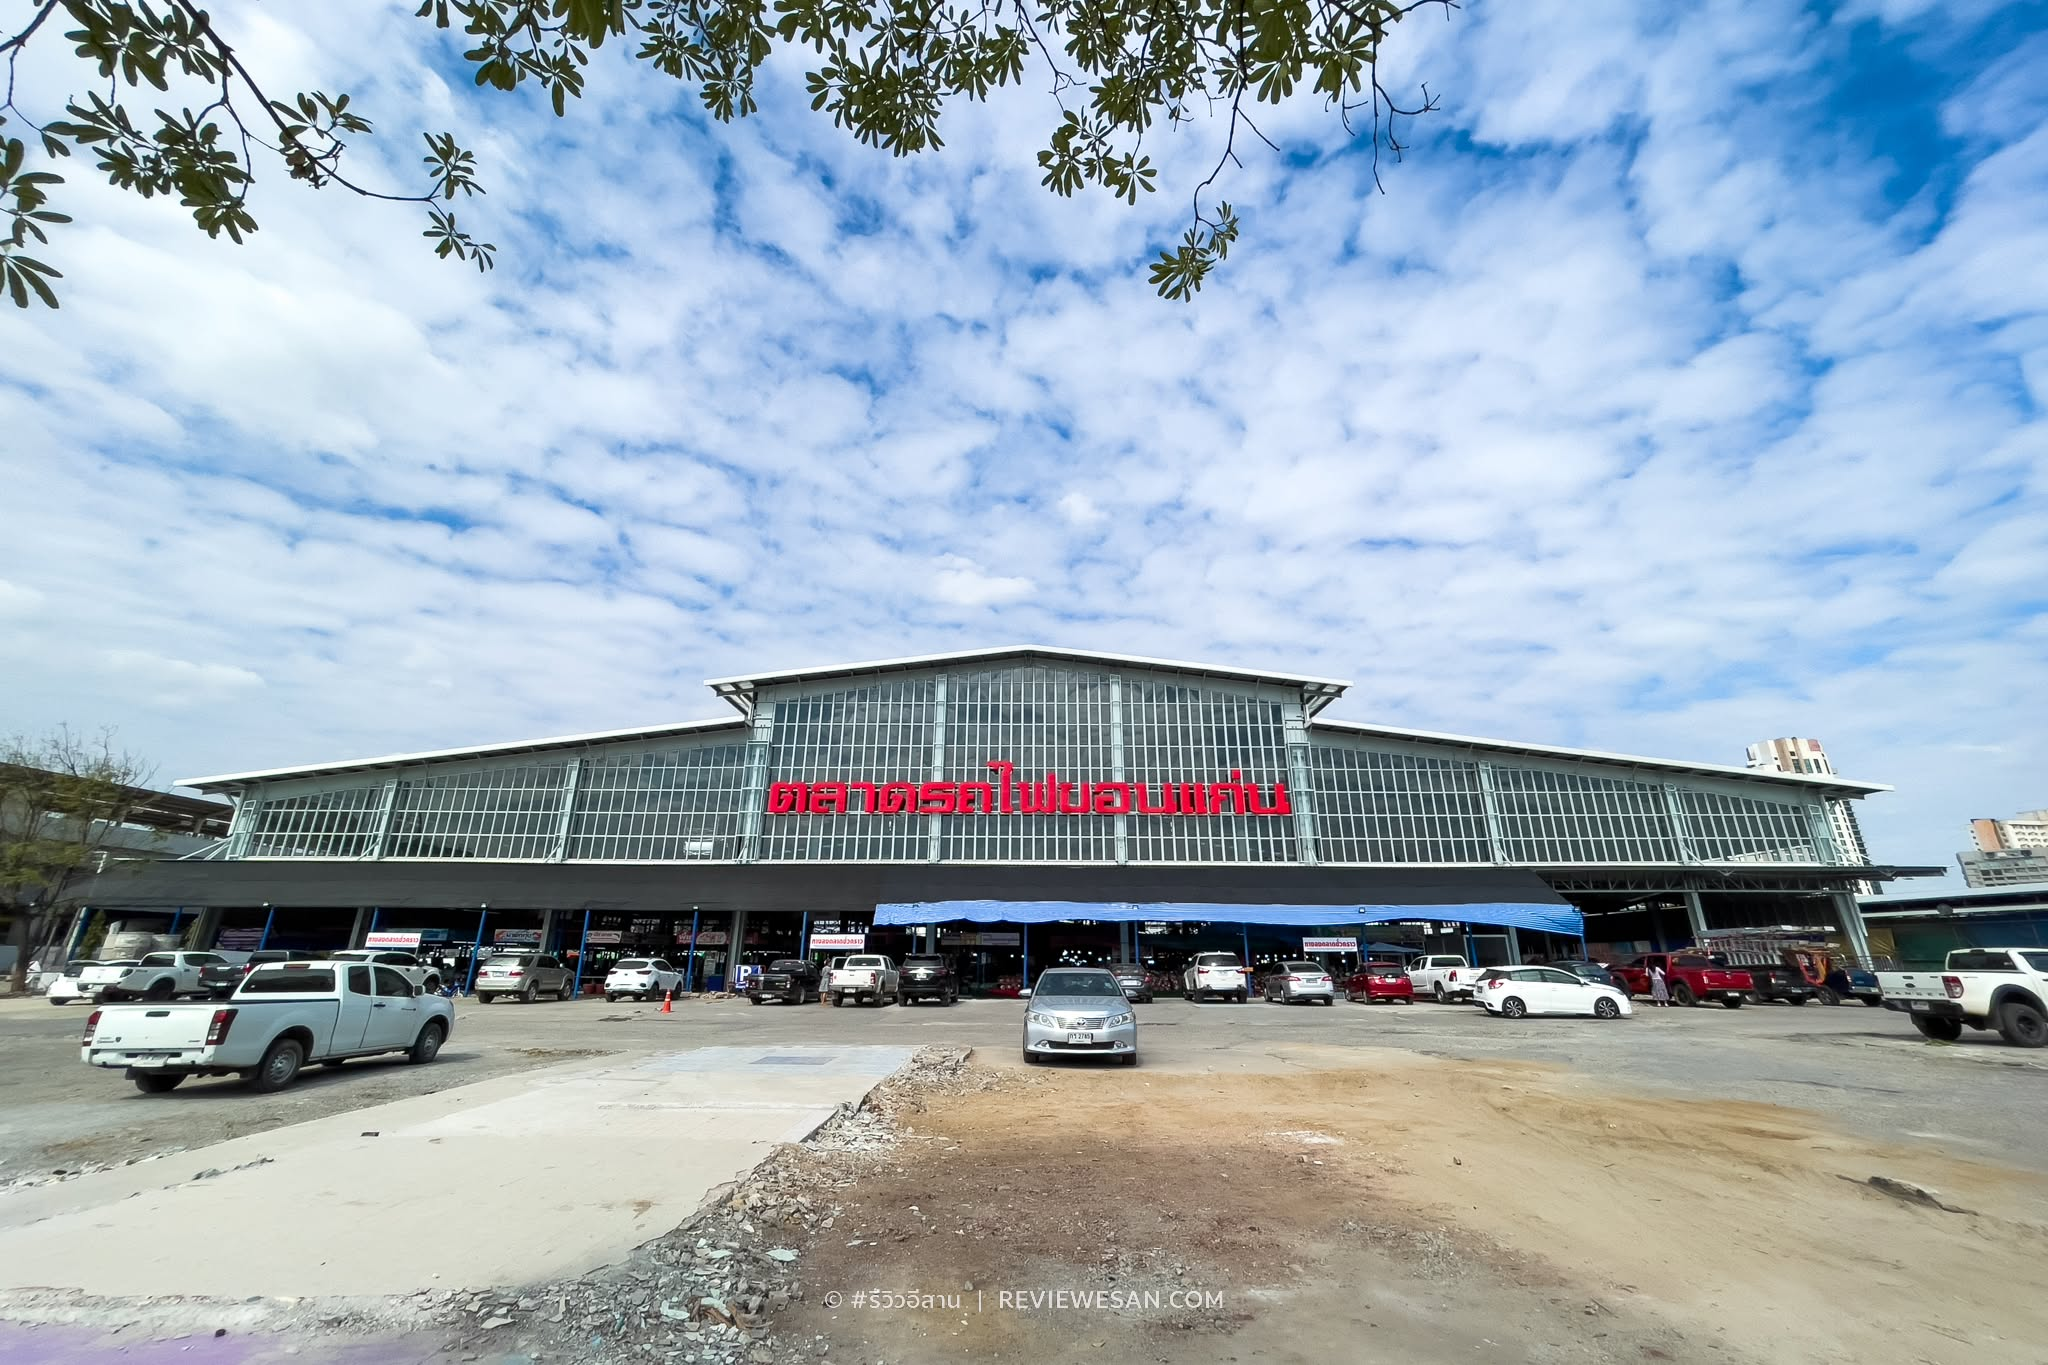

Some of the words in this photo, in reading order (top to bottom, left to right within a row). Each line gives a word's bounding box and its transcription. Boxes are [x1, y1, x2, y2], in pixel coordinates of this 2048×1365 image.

[768, 759, 1291, 816] ตลาดรถไฟขอนแก่น
[740, 965, 752, 981] P
